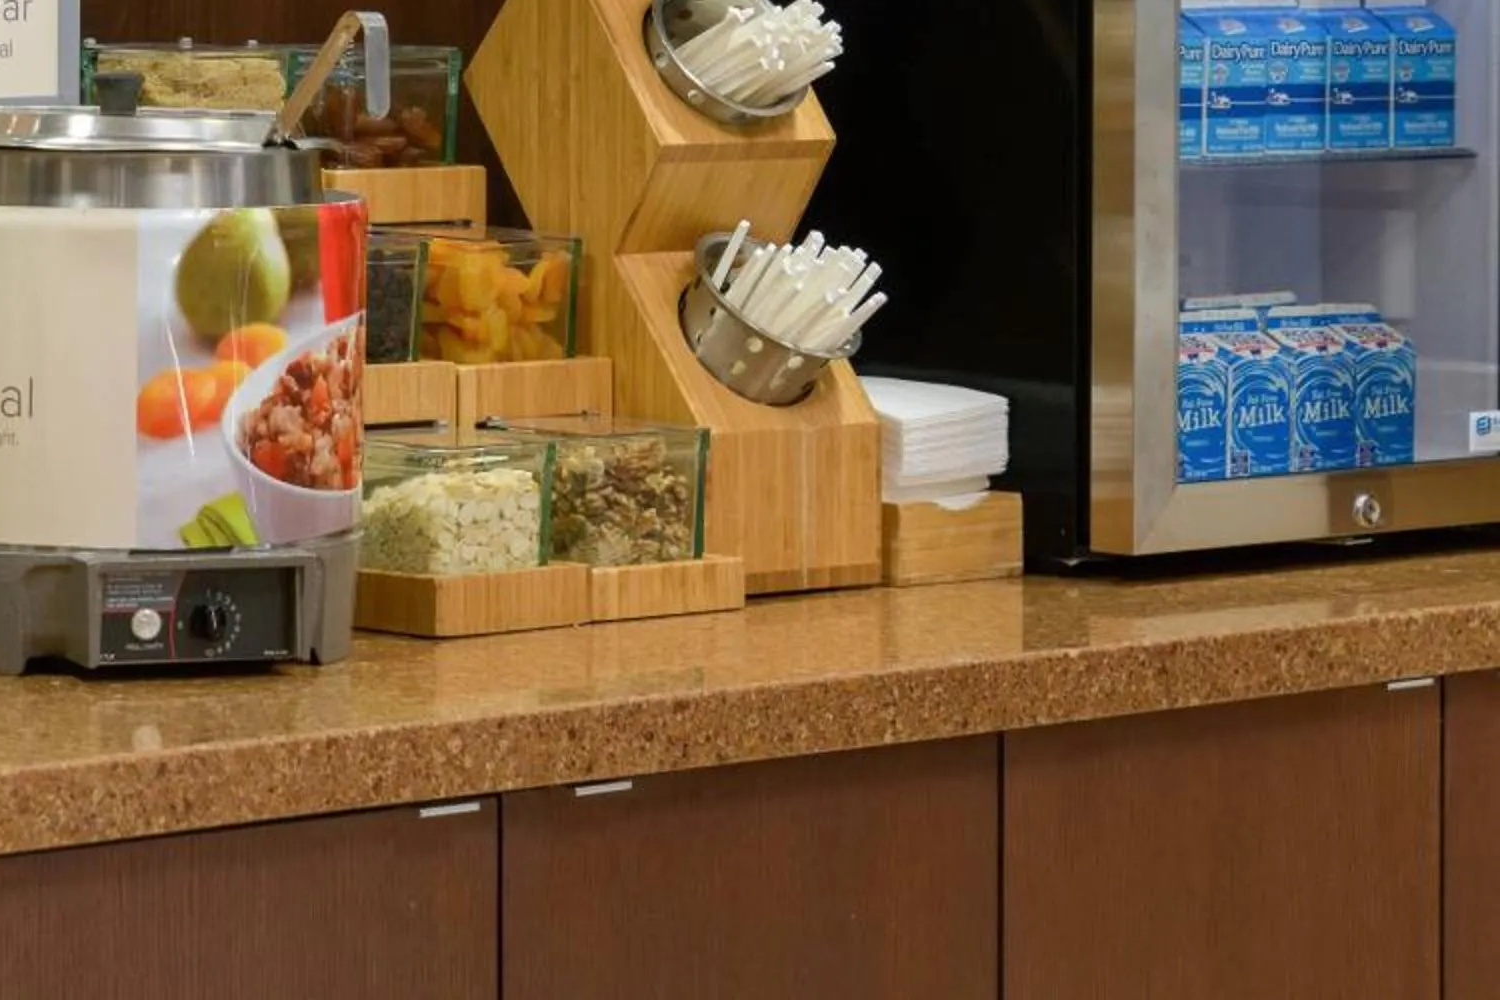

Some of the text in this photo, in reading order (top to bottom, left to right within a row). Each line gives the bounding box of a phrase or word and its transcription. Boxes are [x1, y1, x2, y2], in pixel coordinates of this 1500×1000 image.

[1237, 403, 1287, 429] Milk
[1302, 398, 1350, 425] Milk
[1363, 393, 1410, 420] Milk
[1178, 407, 1222, 433] Milk
